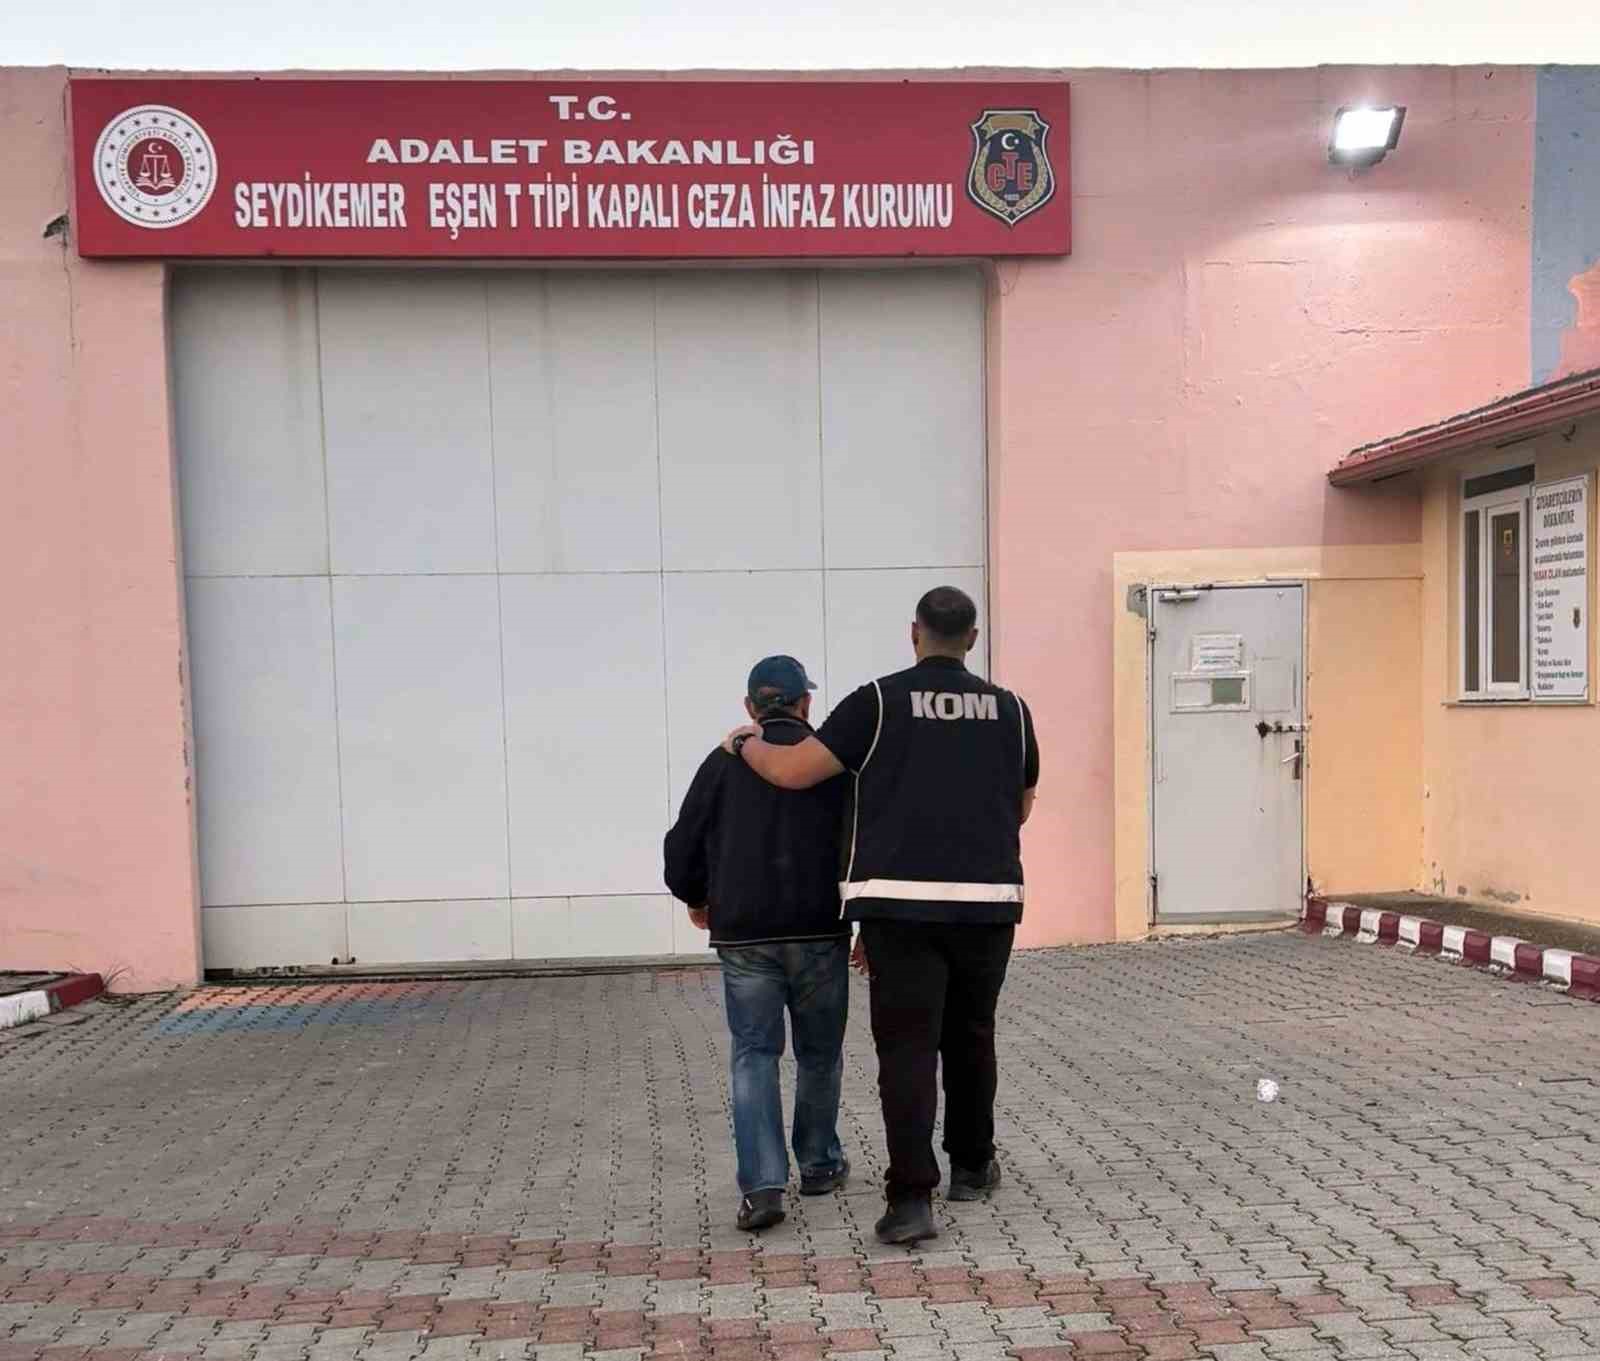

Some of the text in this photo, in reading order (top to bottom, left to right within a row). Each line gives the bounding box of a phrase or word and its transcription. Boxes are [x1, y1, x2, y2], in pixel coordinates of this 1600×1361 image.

[549, 95, 631, 121] T.C.
[366, 134, 814, 165] ADALET BAKANLIĞI
[234, 171, 407, 228] SEYDİKEMER
[429, 182, 497, 240] EŞEN
[504, 183, 522, 228] T
[528, 172, 579, 228] TİPİ
[587, 183, 680, 228] KAPALI
[687, 183, 756, 228] CEZA
[762, 172, 836, 228] İNFAZ
[842, 183, 953, 228] KURUMU
[910, 691, 998, 720] KOM
